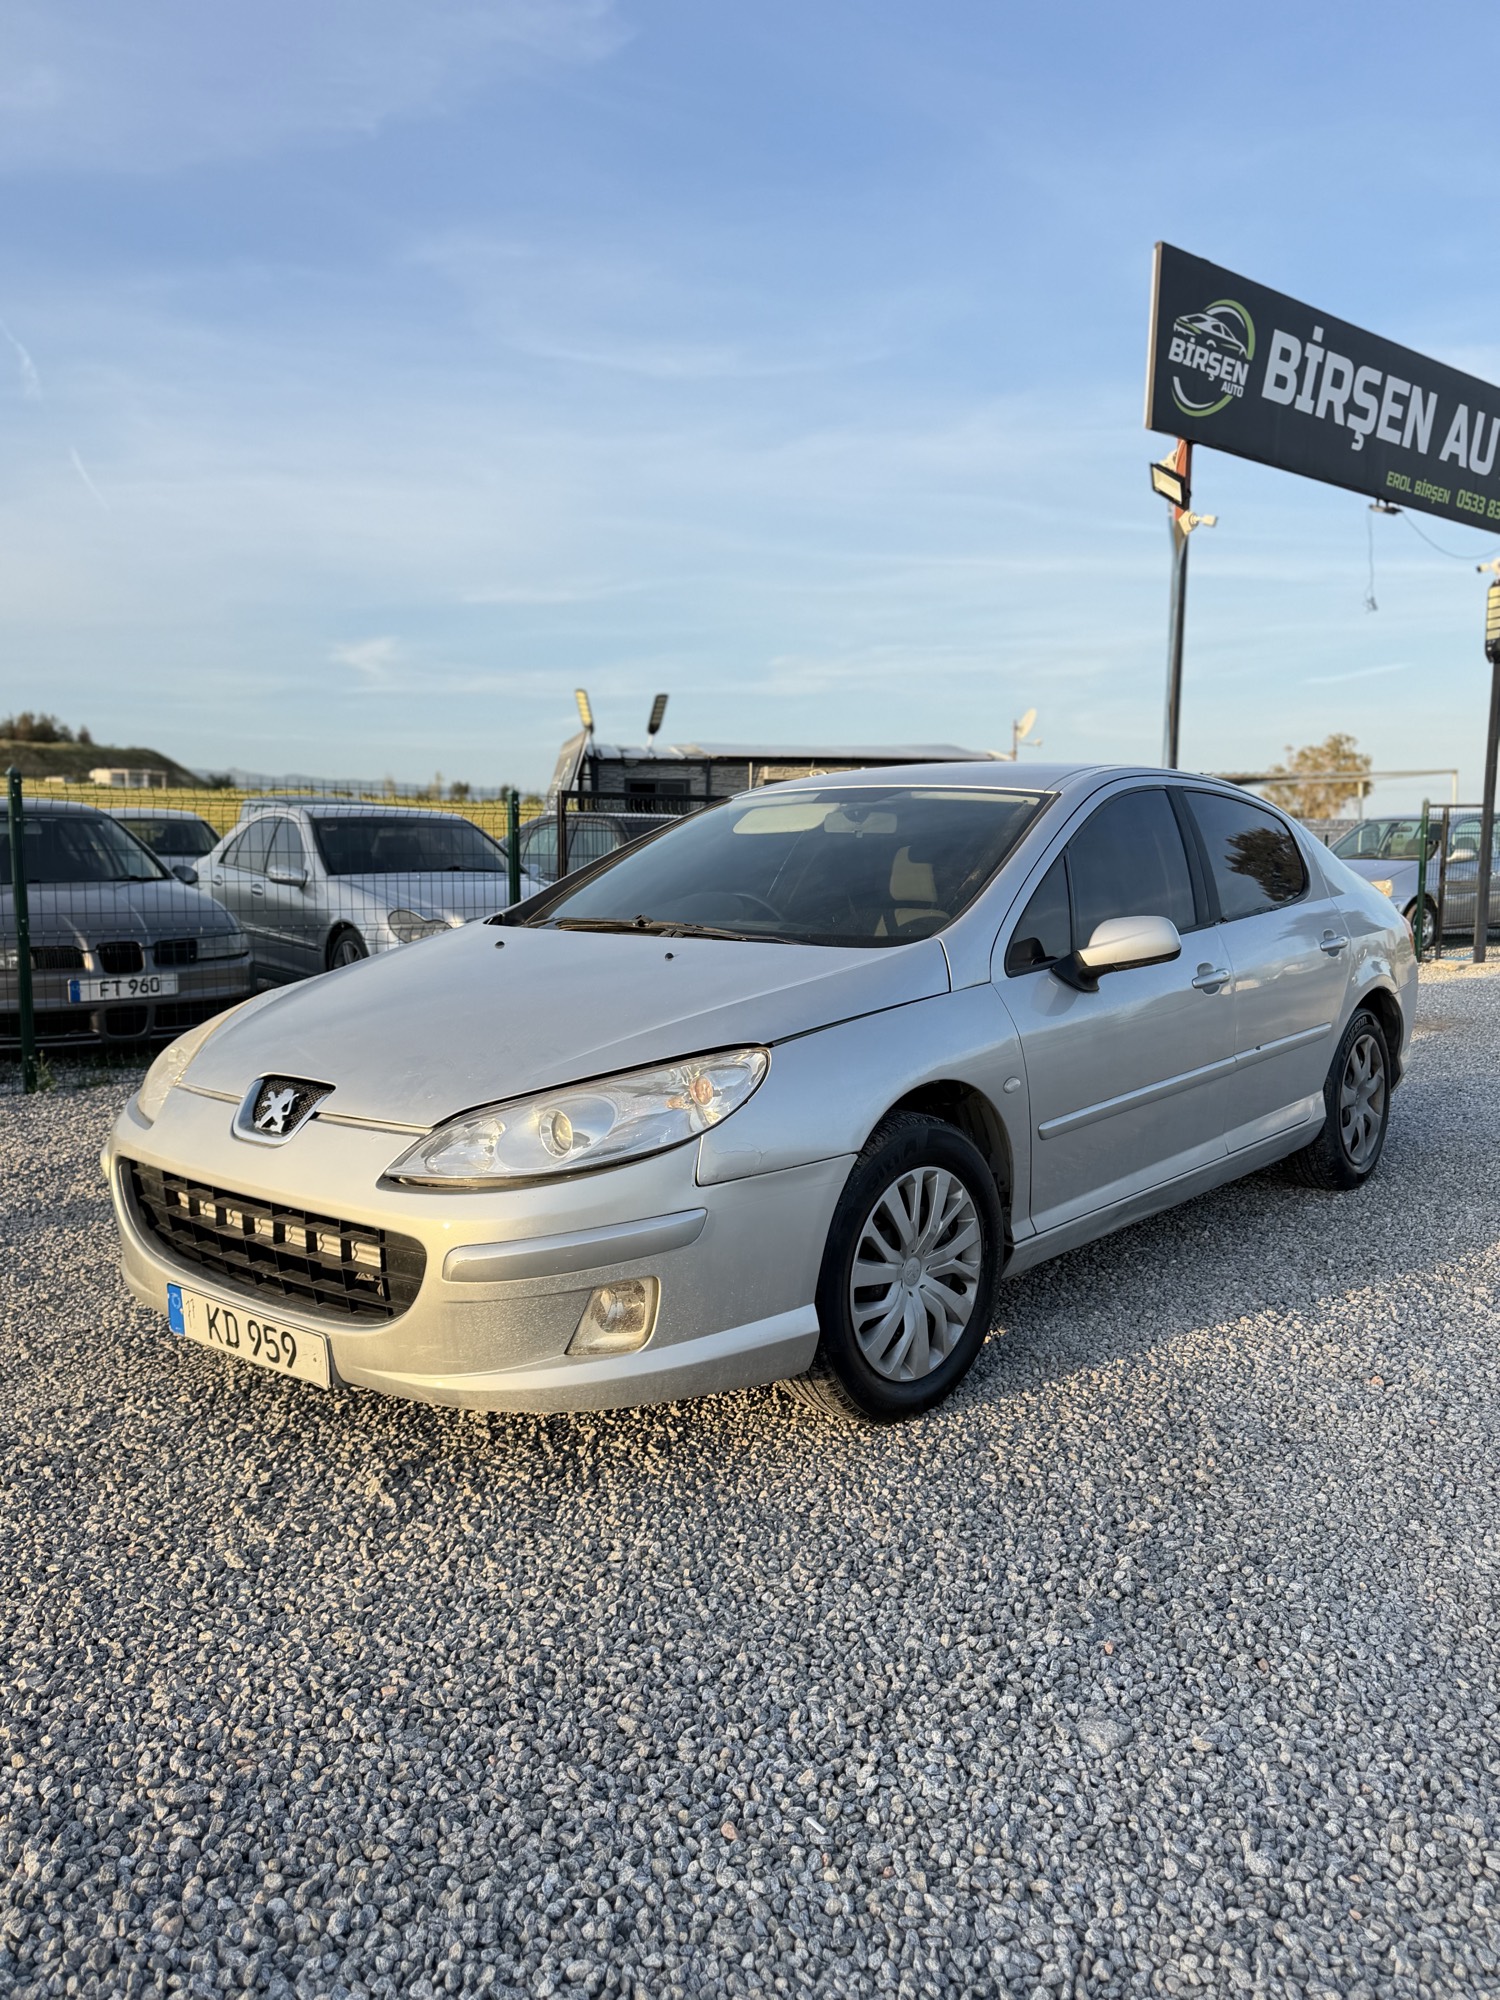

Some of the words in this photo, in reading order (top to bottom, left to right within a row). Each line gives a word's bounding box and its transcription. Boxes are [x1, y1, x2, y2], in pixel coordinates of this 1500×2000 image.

[1168, 337, 1249, 386] BİRŞEN
[1221, 381, 1244, 398] AUTO
[1261, 325, 1438, 455] BİRŞEN
[1439, 403, 1500, 476] AU
[1386, 471, 1412, 493] EROL
[1414, 479, 1451, 504] BİRŞEN
[1456, 489, 1486, 515] 0533
[100, 980, 122, 998] FT
[128, 977, 160, 995] 960
[206, 1303, 240, 1349] KD
[247, 1319, 297, 1369] 959
